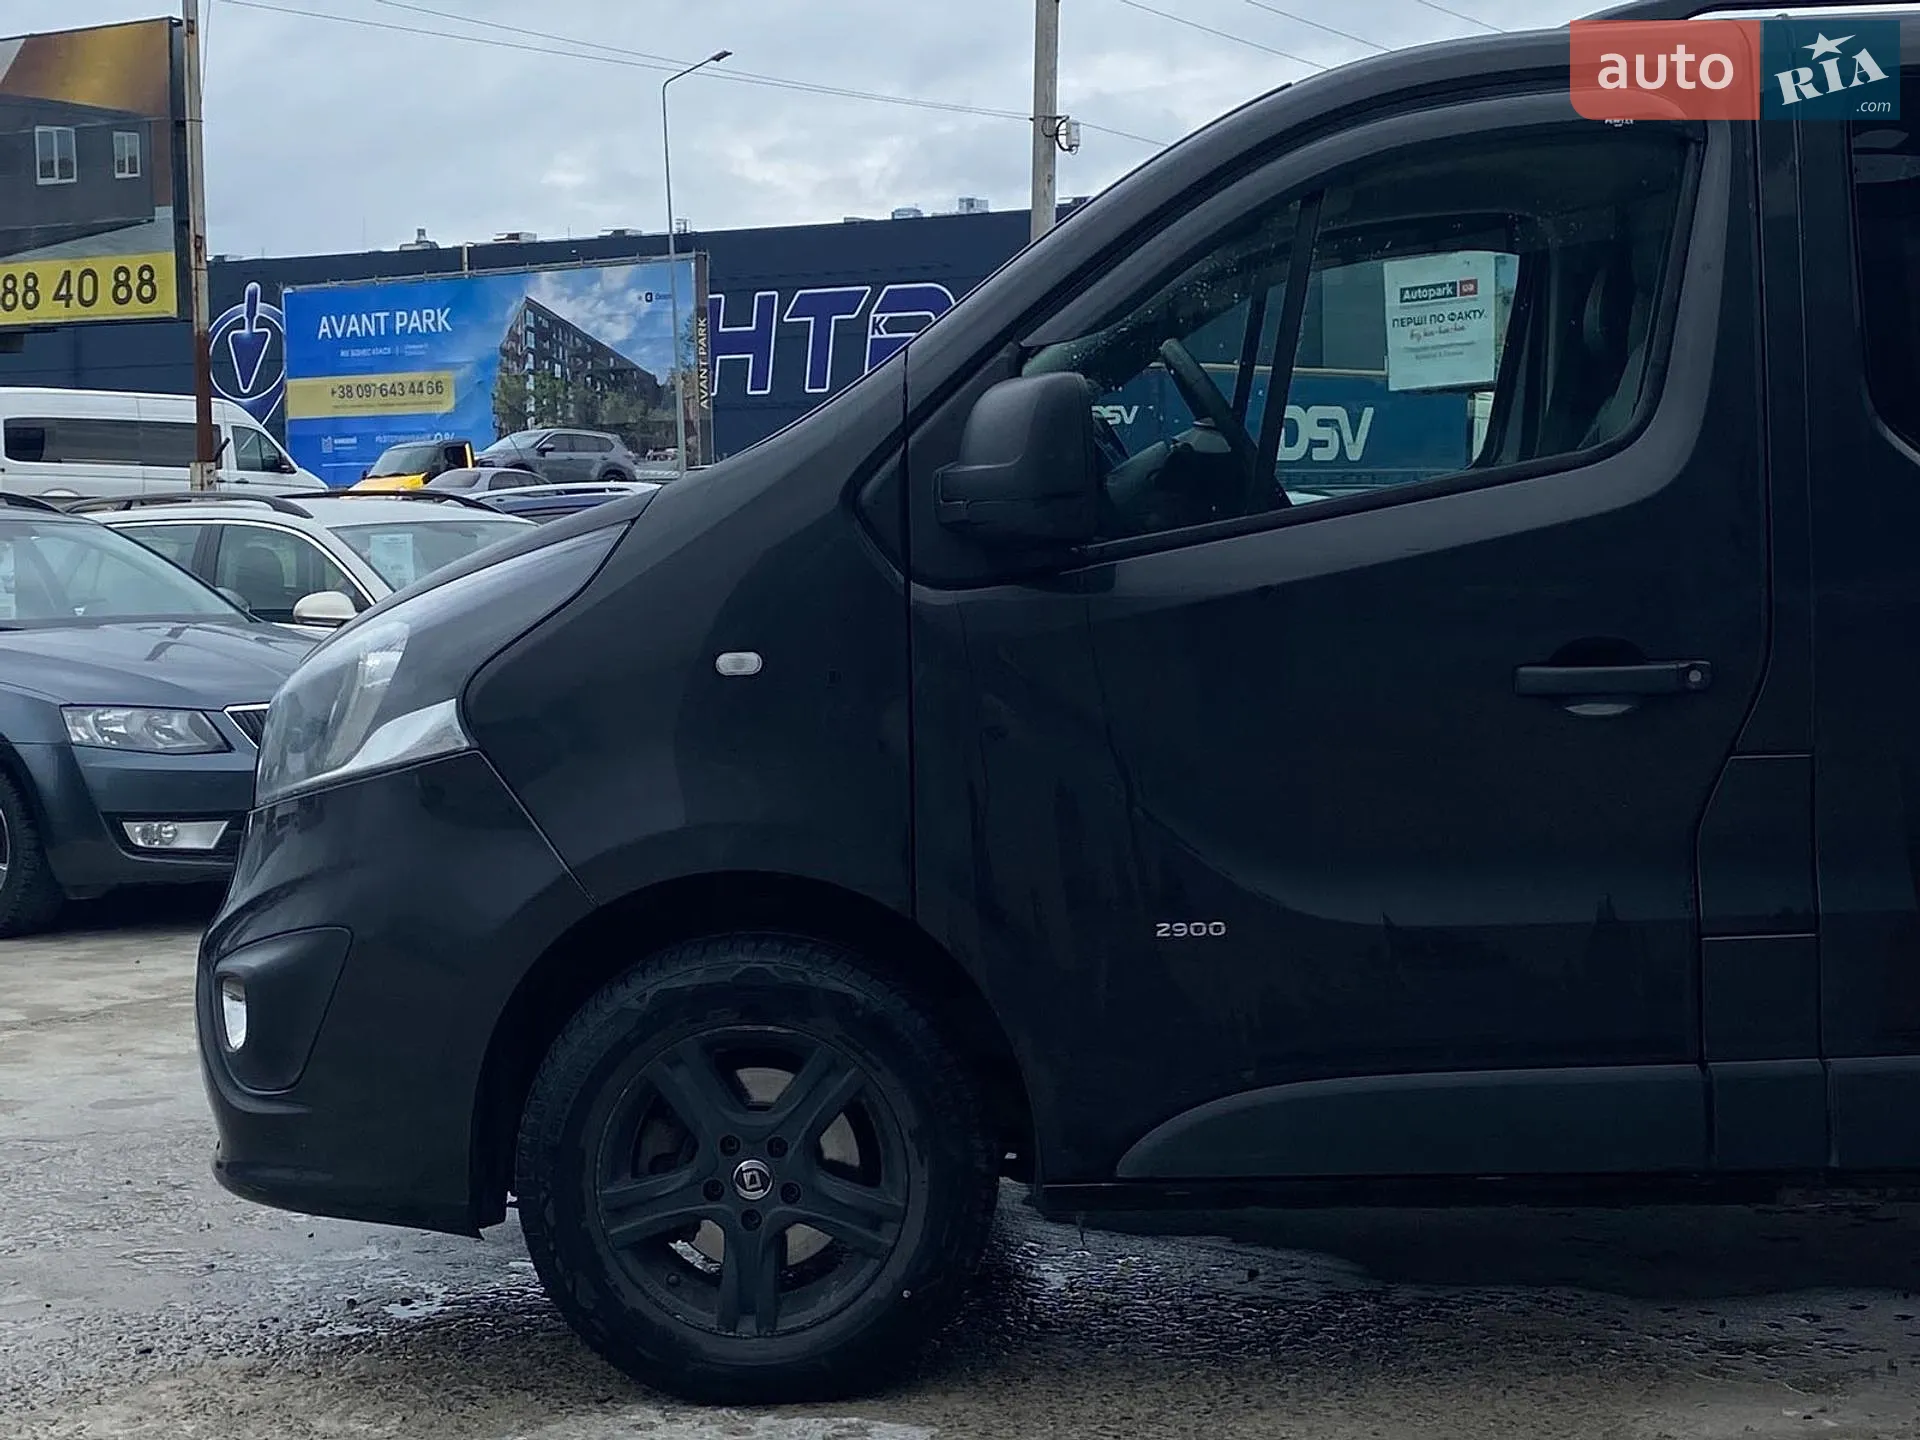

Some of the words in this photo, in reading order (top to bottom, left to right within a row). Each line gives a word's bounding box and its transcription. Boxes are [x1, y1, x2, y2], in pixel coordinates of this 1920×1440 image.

[1, 272, 41, 312] 88
[52, 267, 99, 309] 40
[111, 263, 158, 306] 88
[1402, 282, 1454, 300] Autopark
[317, 311, 390, 341] AVANT
[395, 306, 453, 336] PARK
[697, 317, 708, 356] PARK
[1391, 315, 1428, 329] ПЕРШІ
[1429, 313, 1446, 325] ПО
[379, 381, 406, 397] 643
[426, 380, 445, 396] 66
[699, 359, 709, 410] AVANT
[1276, 404, 1375, 462] DSV
[1155, 921, 1227, 937] 2900
